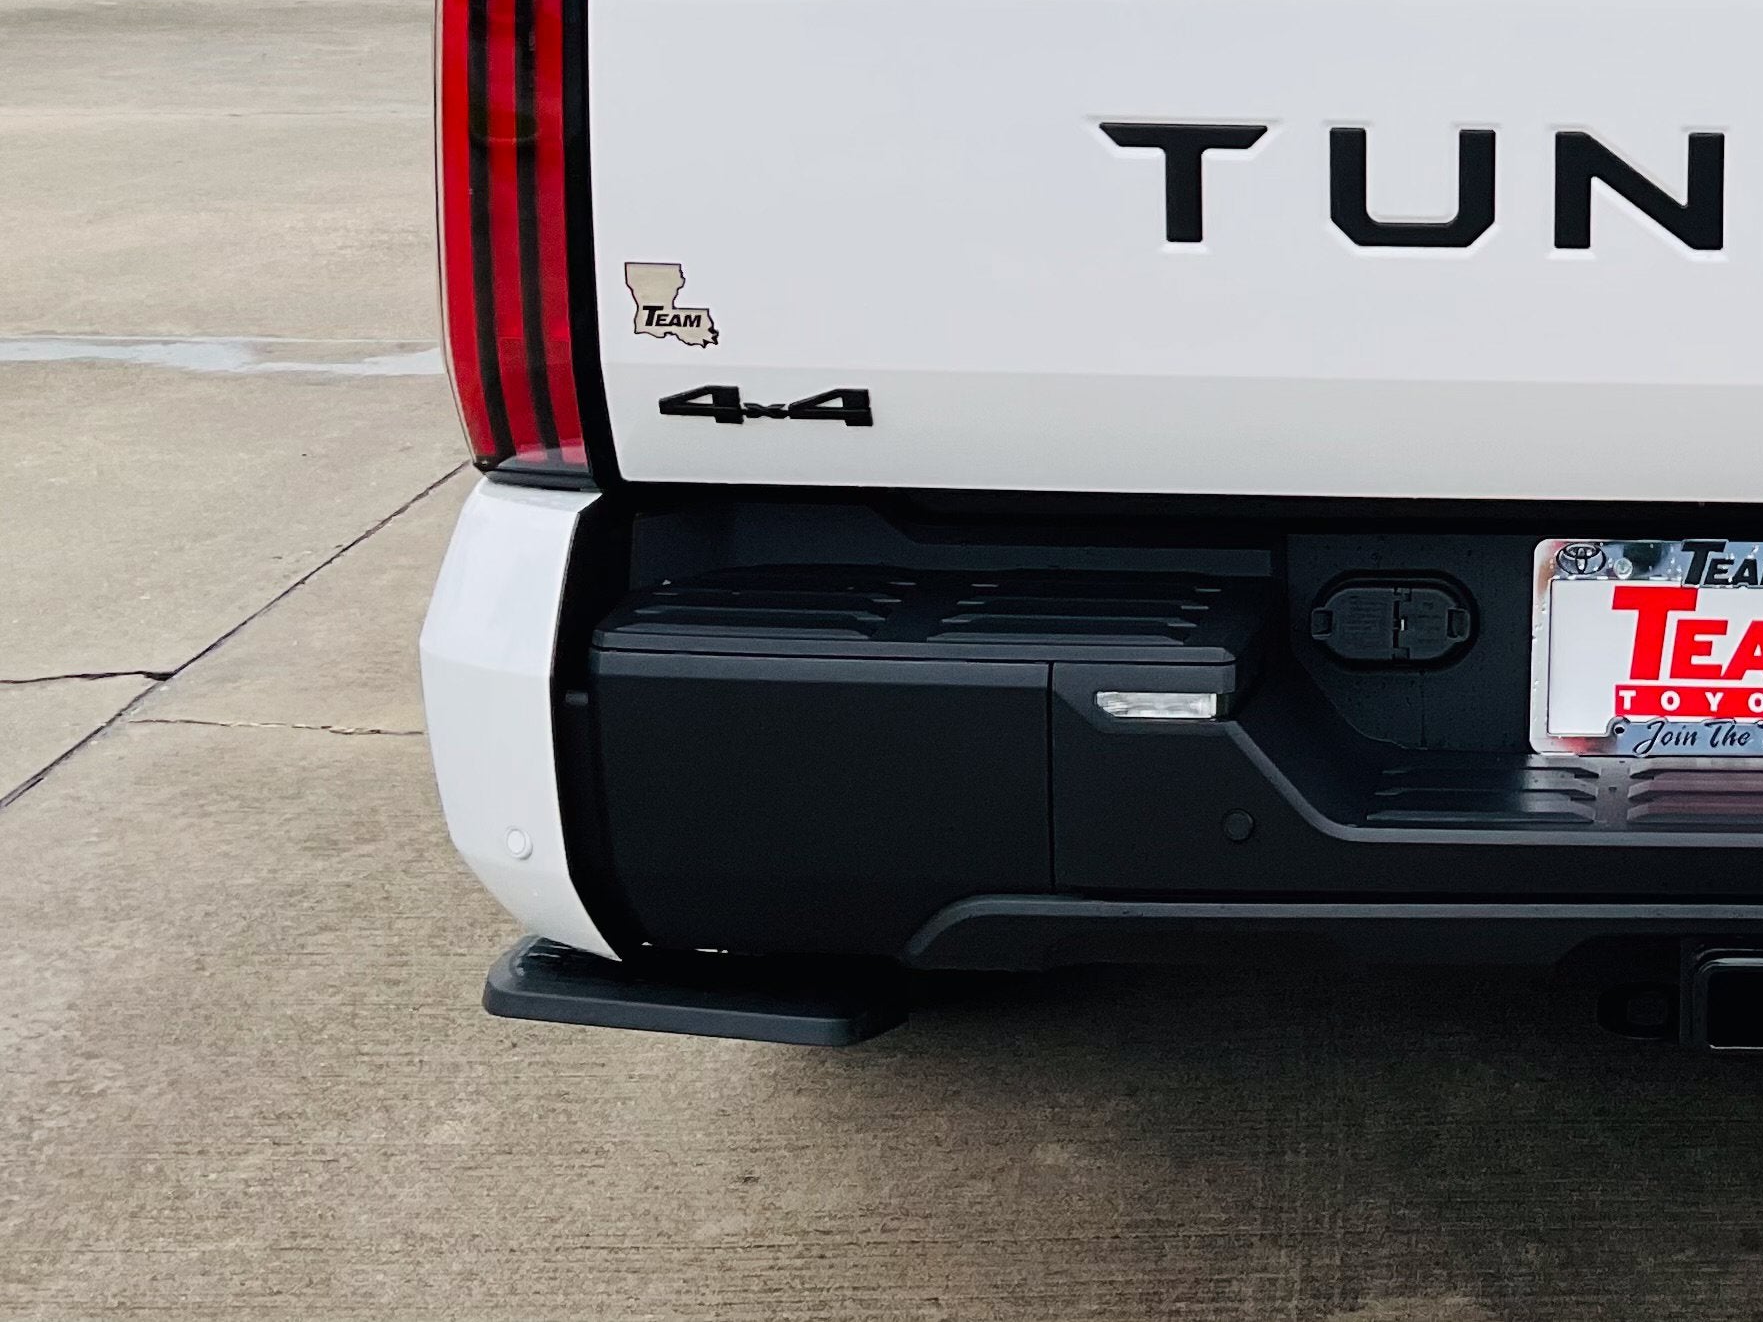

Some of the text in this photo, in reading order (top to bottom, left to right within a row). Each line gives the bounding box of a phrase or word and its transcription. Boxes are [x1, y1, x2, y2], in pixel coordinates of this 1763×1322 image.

[642, 305, 702, 328] TEAM
[1633, 720, 1698, 754] Join
[1702, 719, 1751, 748] The
